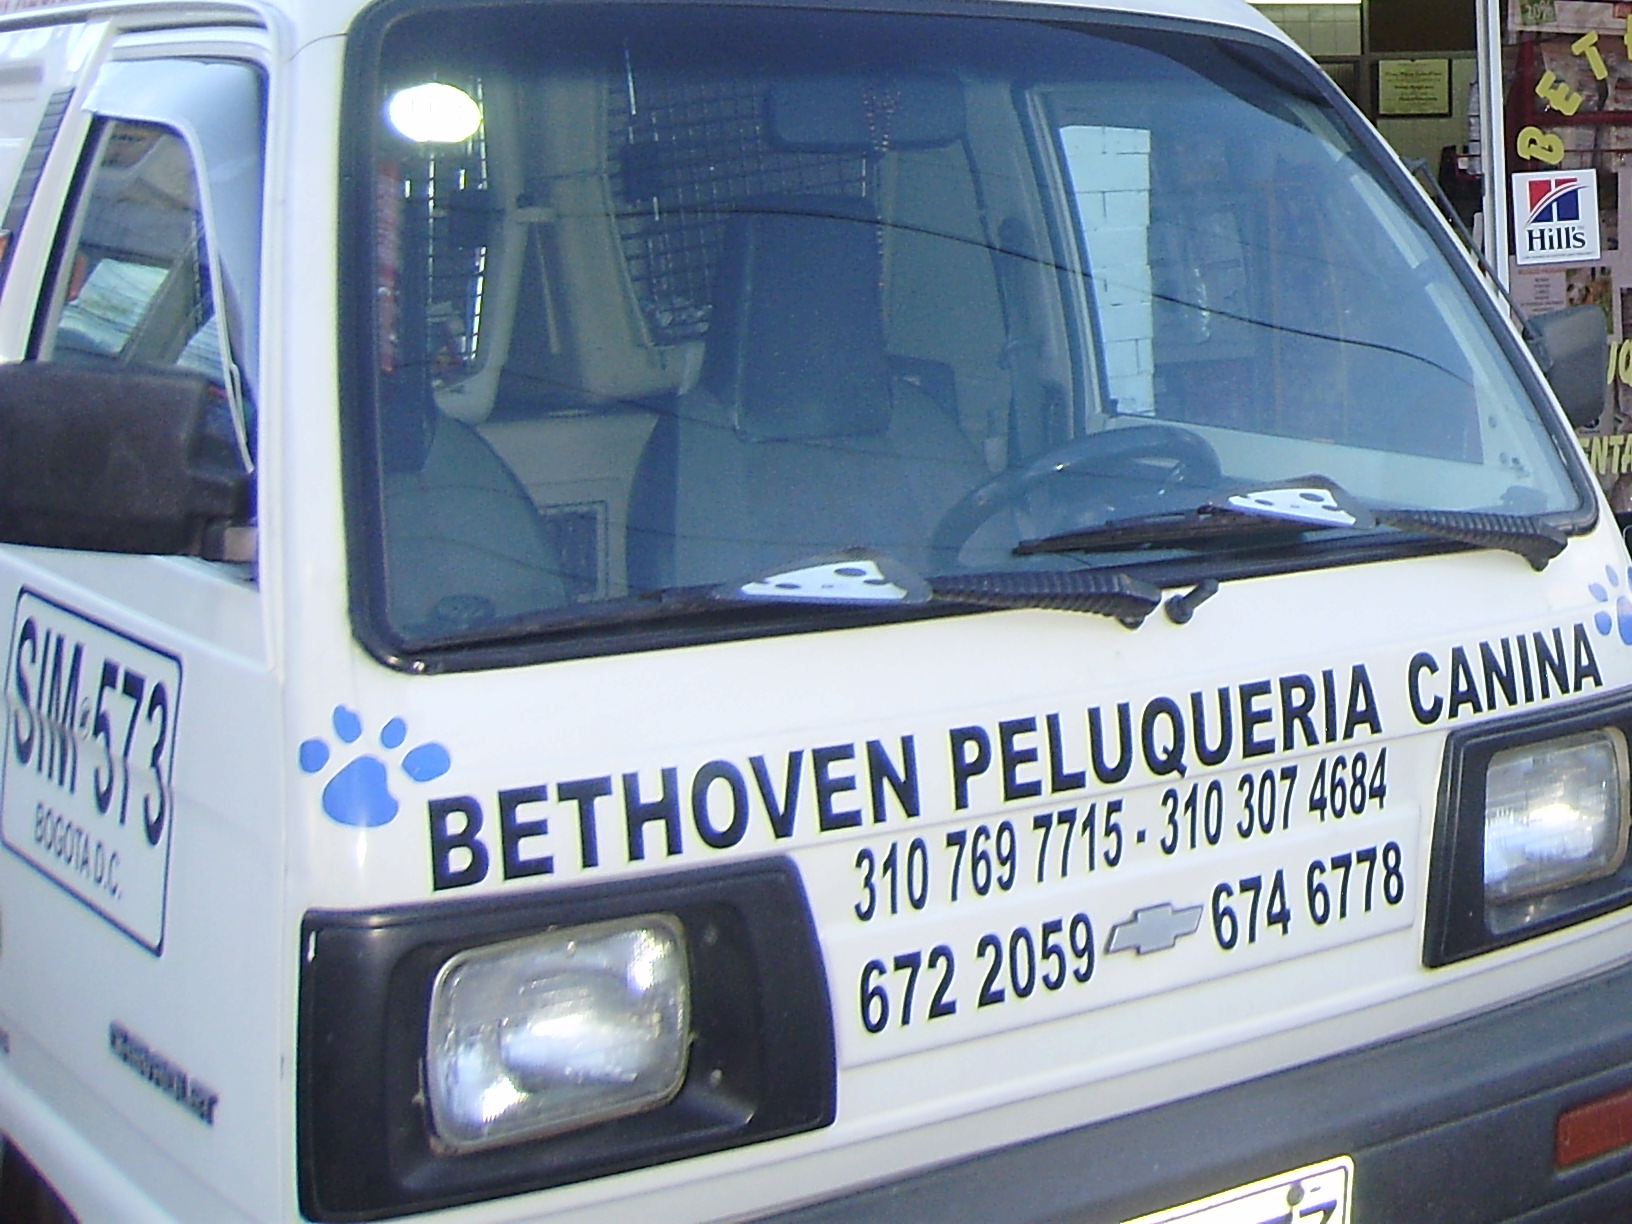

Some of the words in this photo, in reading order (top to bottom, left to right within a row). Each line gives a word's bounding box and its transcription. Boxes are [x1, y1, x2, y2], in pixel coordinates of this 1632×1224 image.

[1526, 227, 1587, 252] Hill's
[34, 801, 90, 878] BOGOTA
[427, 733, 921, 893] BETHOVEN
[949, 662, 1383, 810] PELUQUERIA
[1407, 622, 1603, 726] CANINA
[853, 836, 929, 922] 310
[945, 819, 1017, 903] 769
[1032, 797, 1124, 880] 7715
[1159, 778, 1223, 856] 310
[1235, 763, 1299, 840] 307
[1308, 746, 1388, 823] 4684
[859, 943, 957, 1035] 672
[975, 912, 1096, 1010] 2059
[1210, 868, 1292, 952] 674
[1305, 839, 1405, 928] 6778
